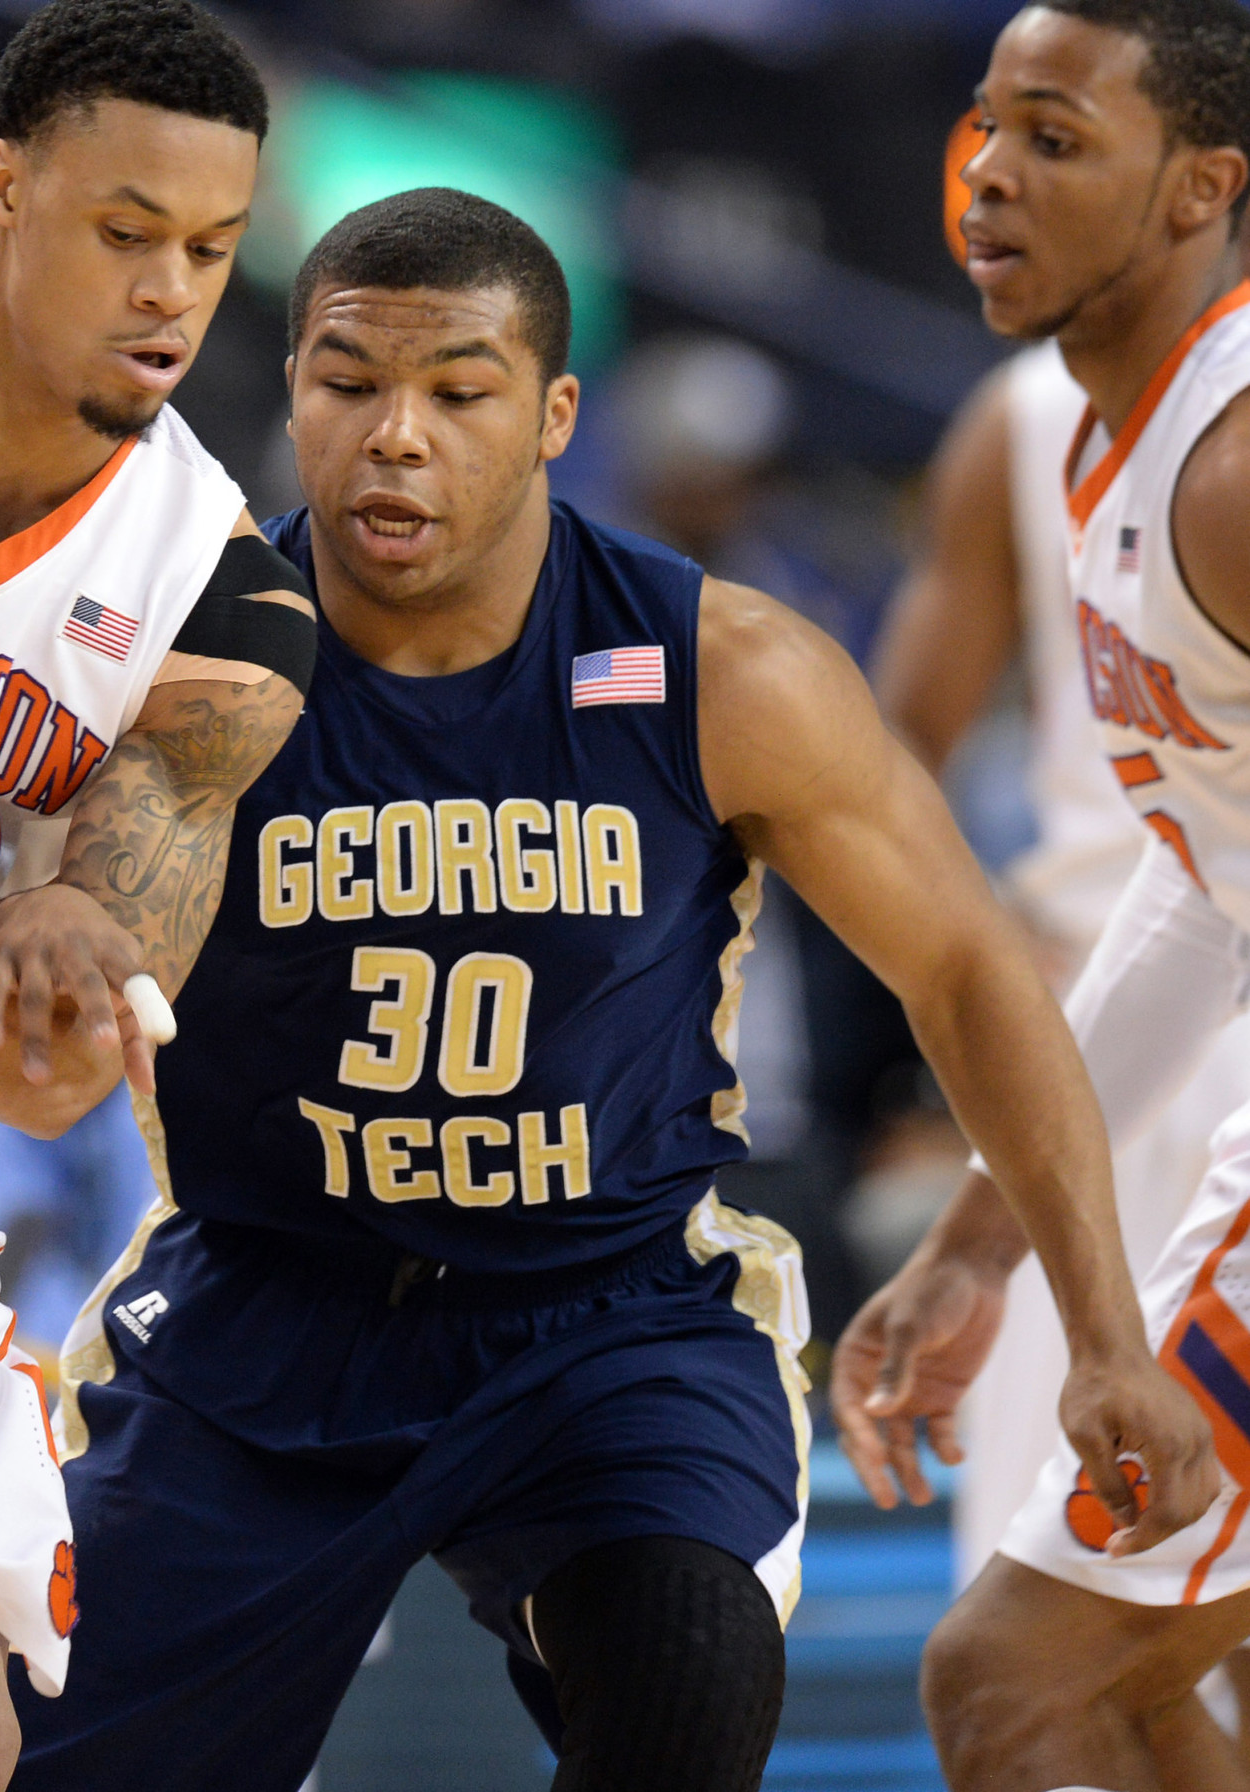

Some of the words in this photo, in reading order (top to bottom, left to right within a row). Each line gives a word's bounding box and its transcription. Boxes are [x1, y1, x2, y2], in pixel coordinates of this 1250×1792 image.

[258, 797, 644, 929] GEORGIA
[337, 946, 534, 1098] 30
[297, 1096, 592, 1209] TECH
